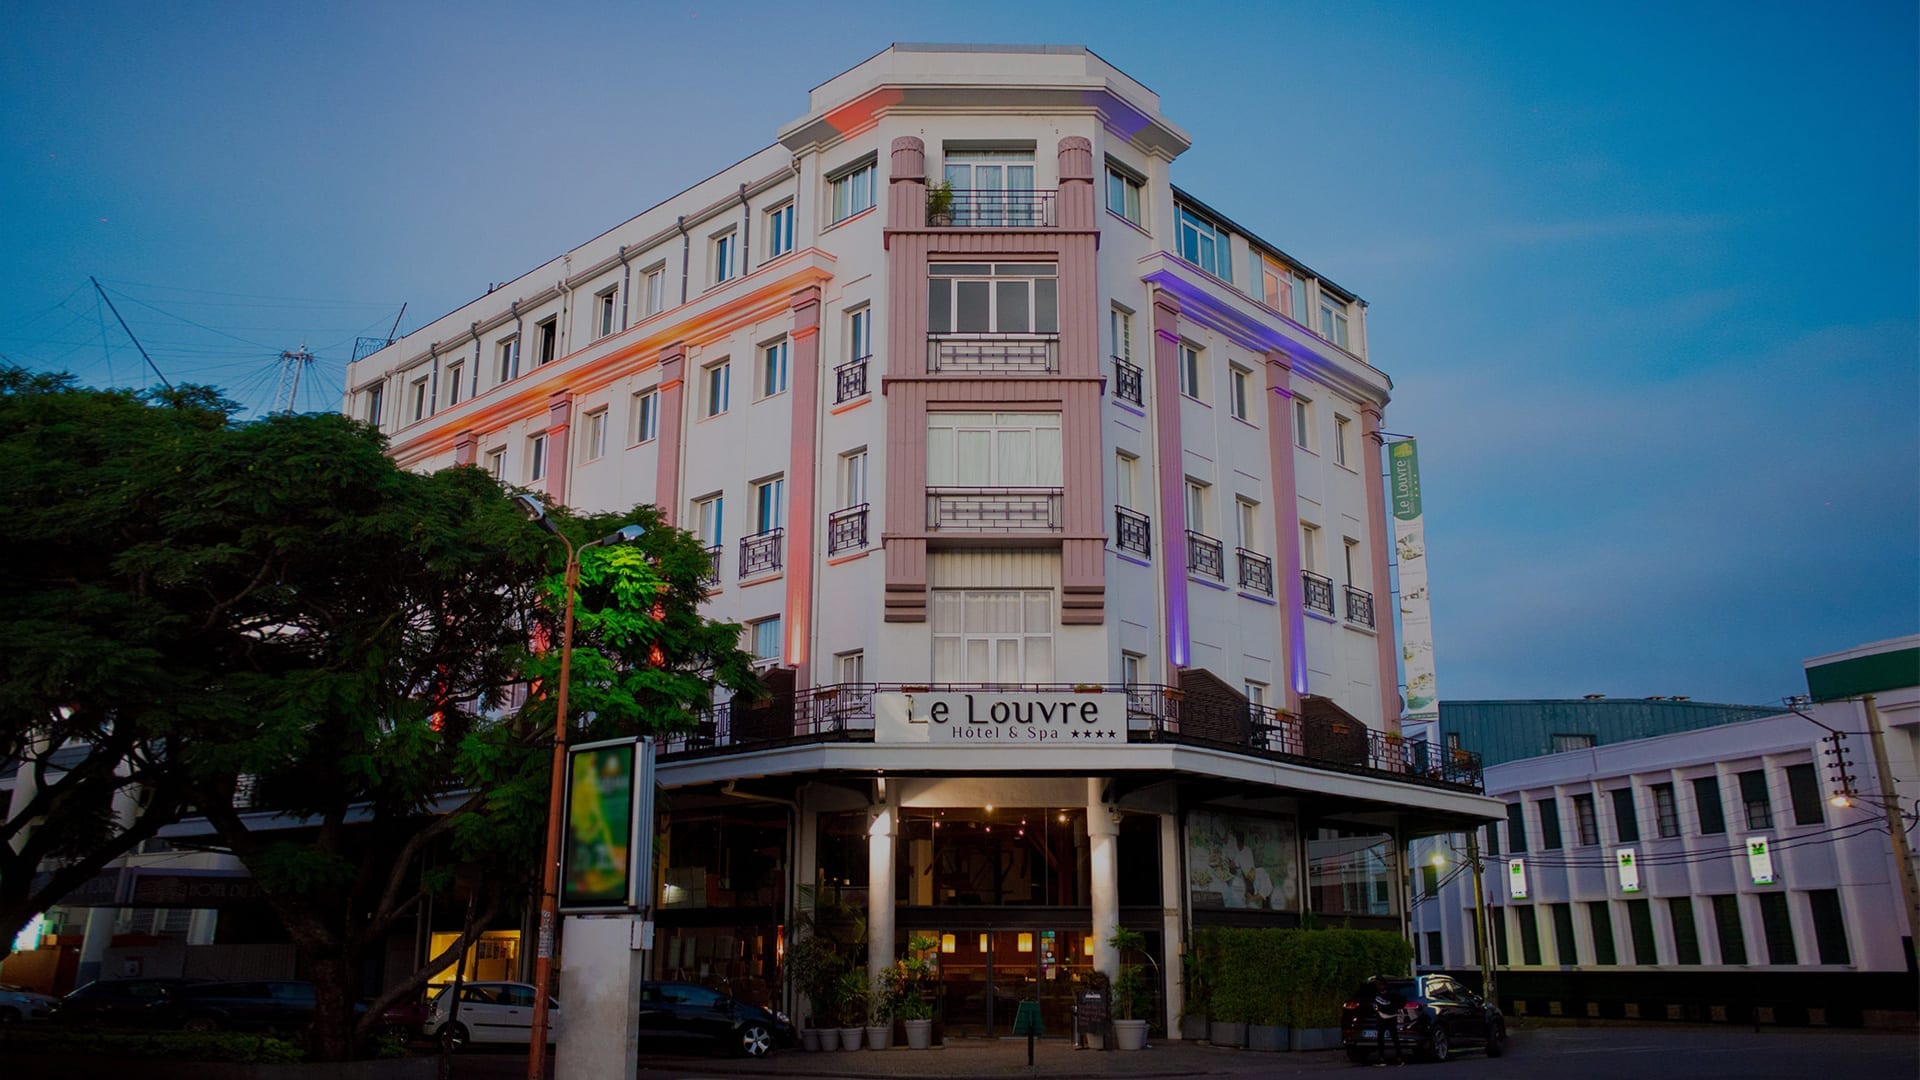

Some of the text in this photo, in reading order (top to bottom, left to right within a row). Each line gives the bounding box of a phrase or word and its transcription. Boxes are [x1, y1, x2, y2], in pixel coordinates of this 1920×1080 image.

[1396, 459, 1409, 499] Louvre
[1397, 501, 1410, 515] Le
[905, 694, 1098, 724] Le Louvre
[952, 726, 1058, 741] Hôtel & Spa
